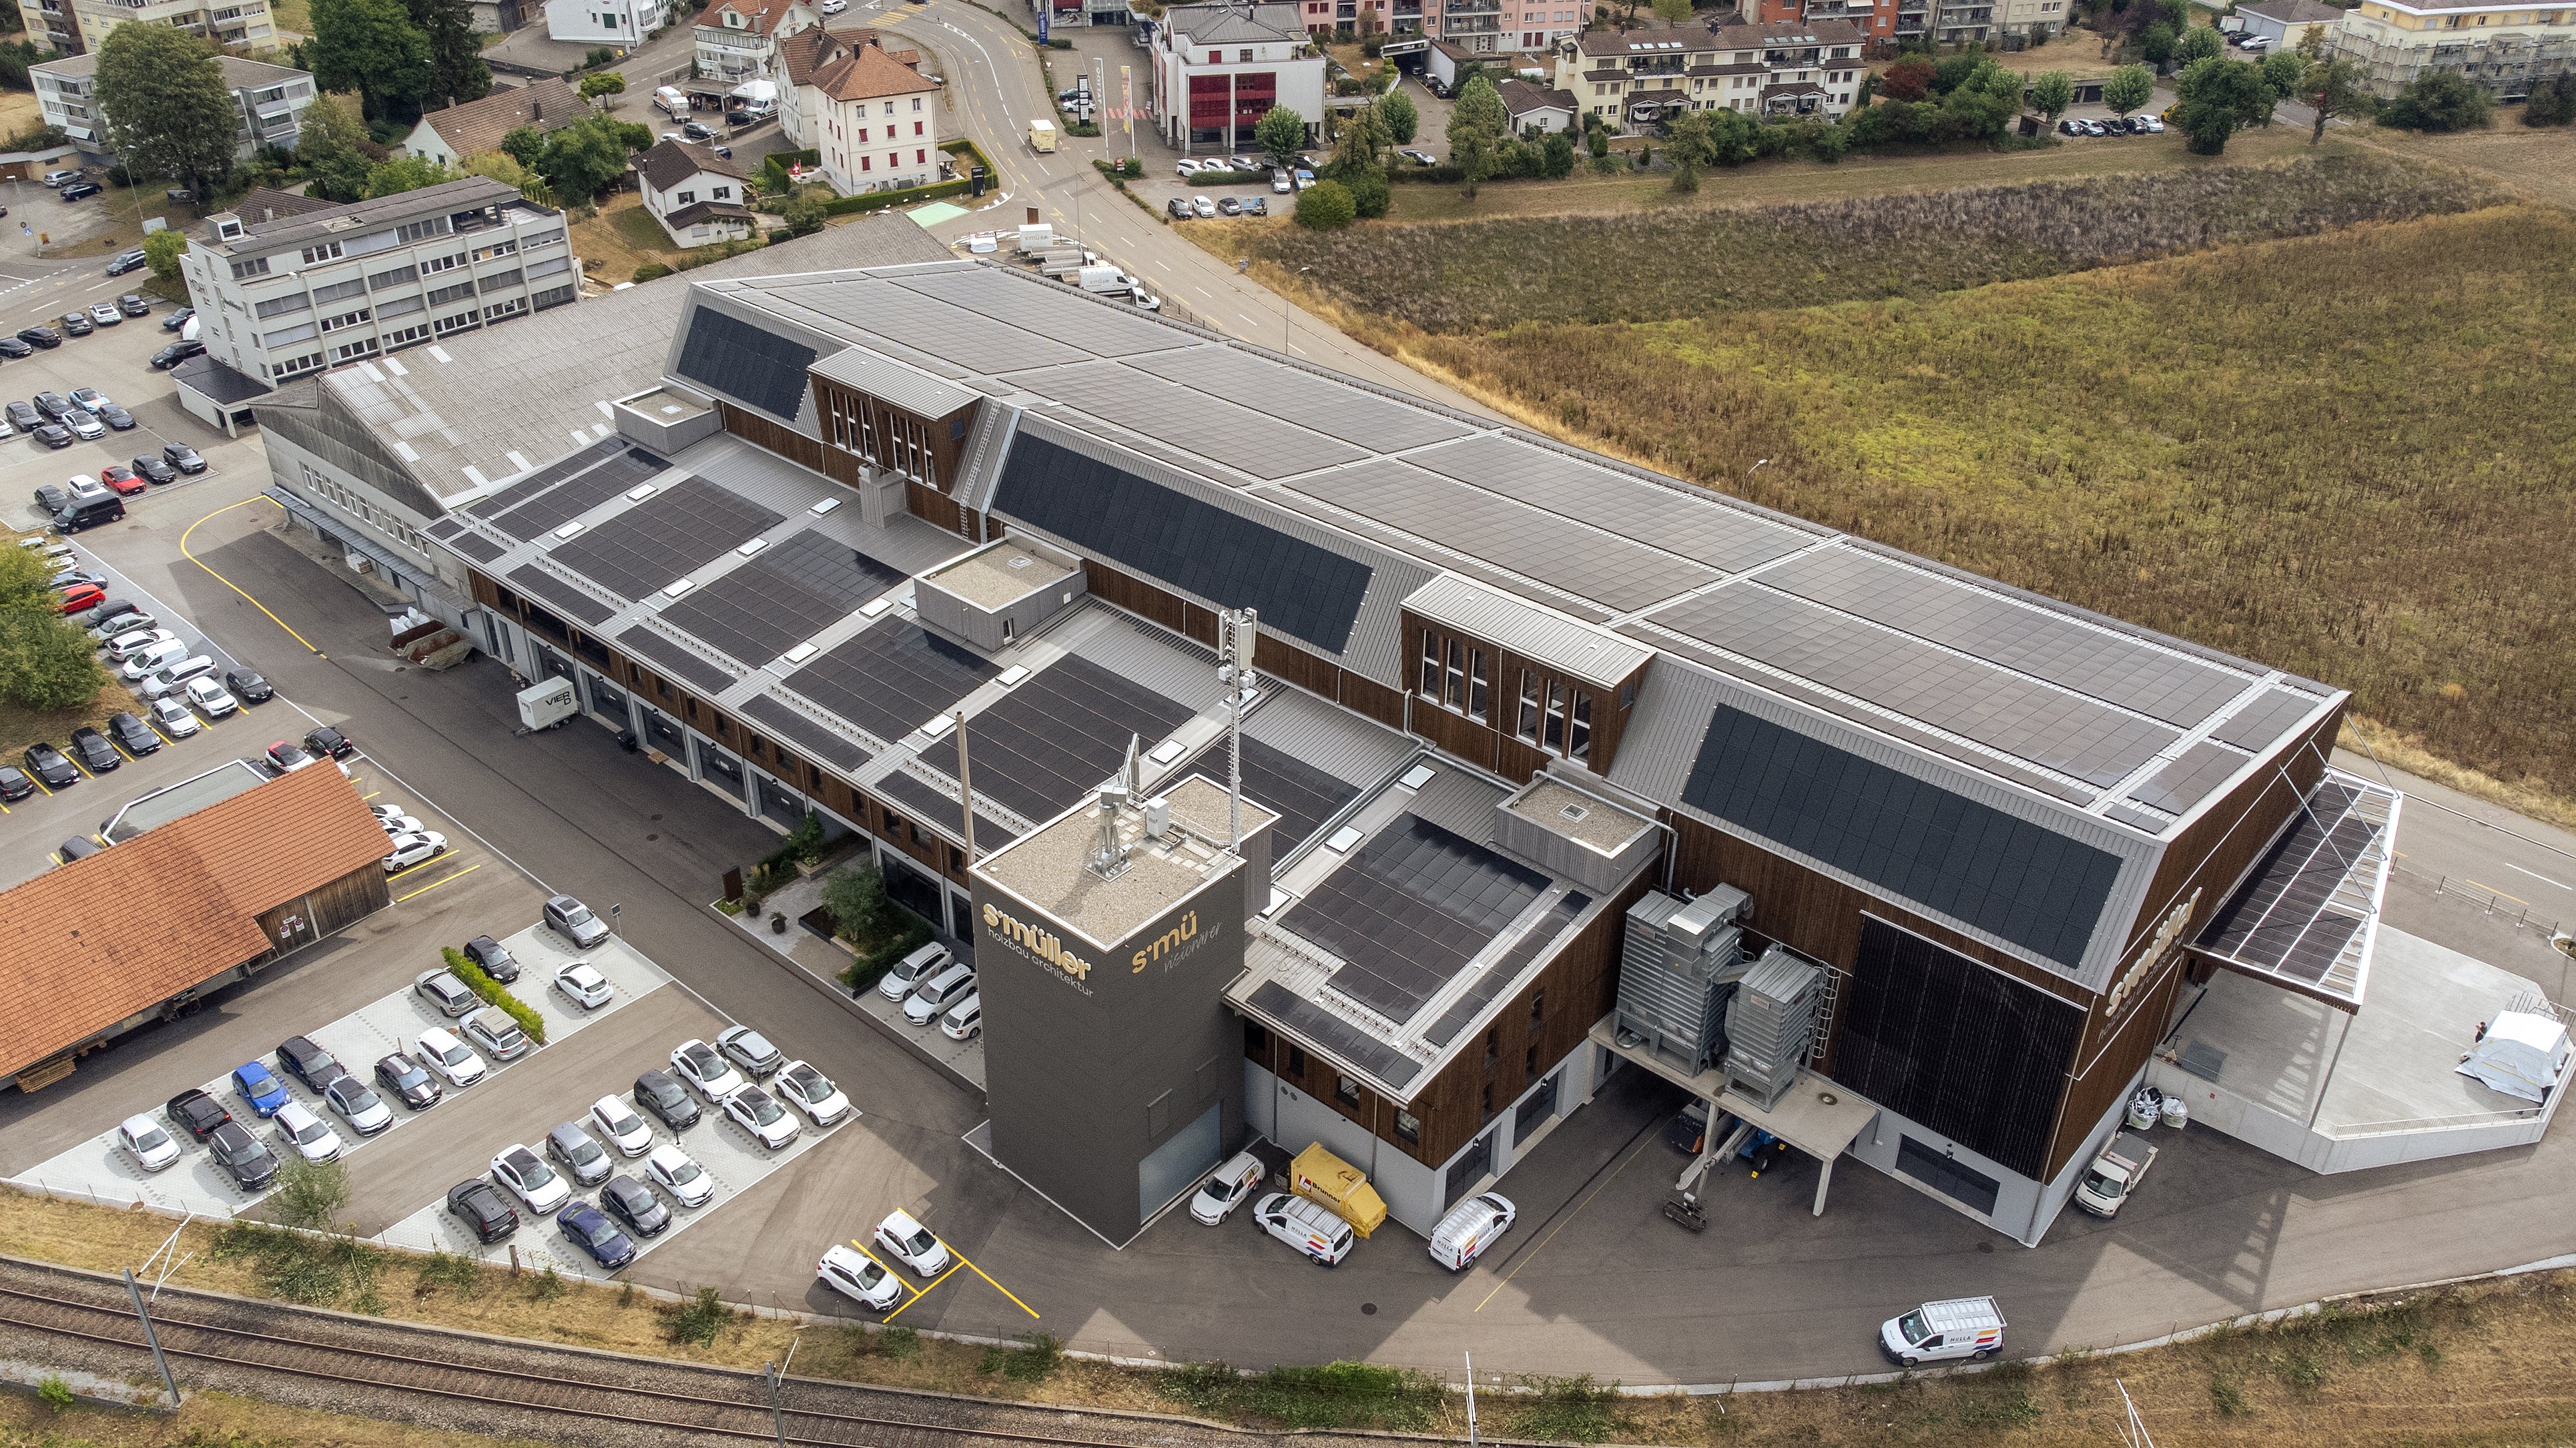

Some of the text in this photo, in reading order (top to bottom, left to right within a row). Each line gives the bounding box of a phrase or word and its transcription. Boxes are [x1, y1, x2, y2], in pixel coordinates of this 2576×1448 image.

[545, 691, 570, 705] VIER
[988, 926, 1094, 998] holzbau architektur
[1312, 1182, 1341, 1204] Brunner
